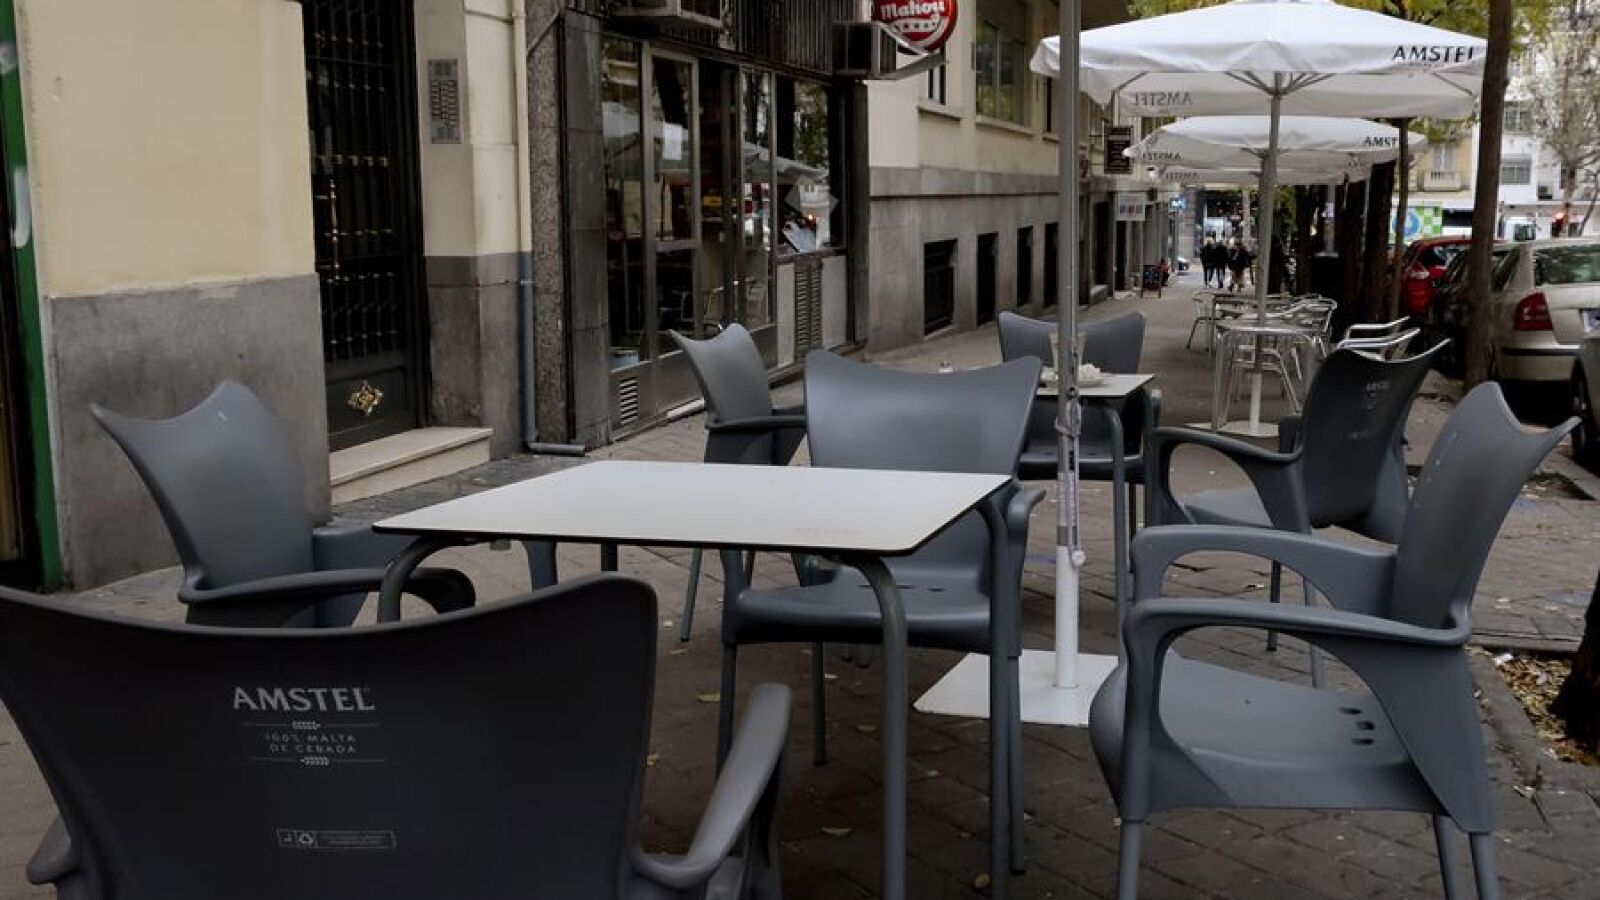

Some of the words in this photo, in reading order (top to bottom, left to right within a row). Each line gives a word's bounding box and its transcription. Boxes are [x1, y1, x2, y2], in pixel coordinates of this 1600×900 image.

[880, 0, 945, 19] Mahou
[1363, 136, 1399, 147] AMST
[232, 686, 376, 712] AMSTEL
[307, 733, 357, 743] MALTA
[269, 743, 288, 753] DE
[296, 743, 357, 753] CEBADA
